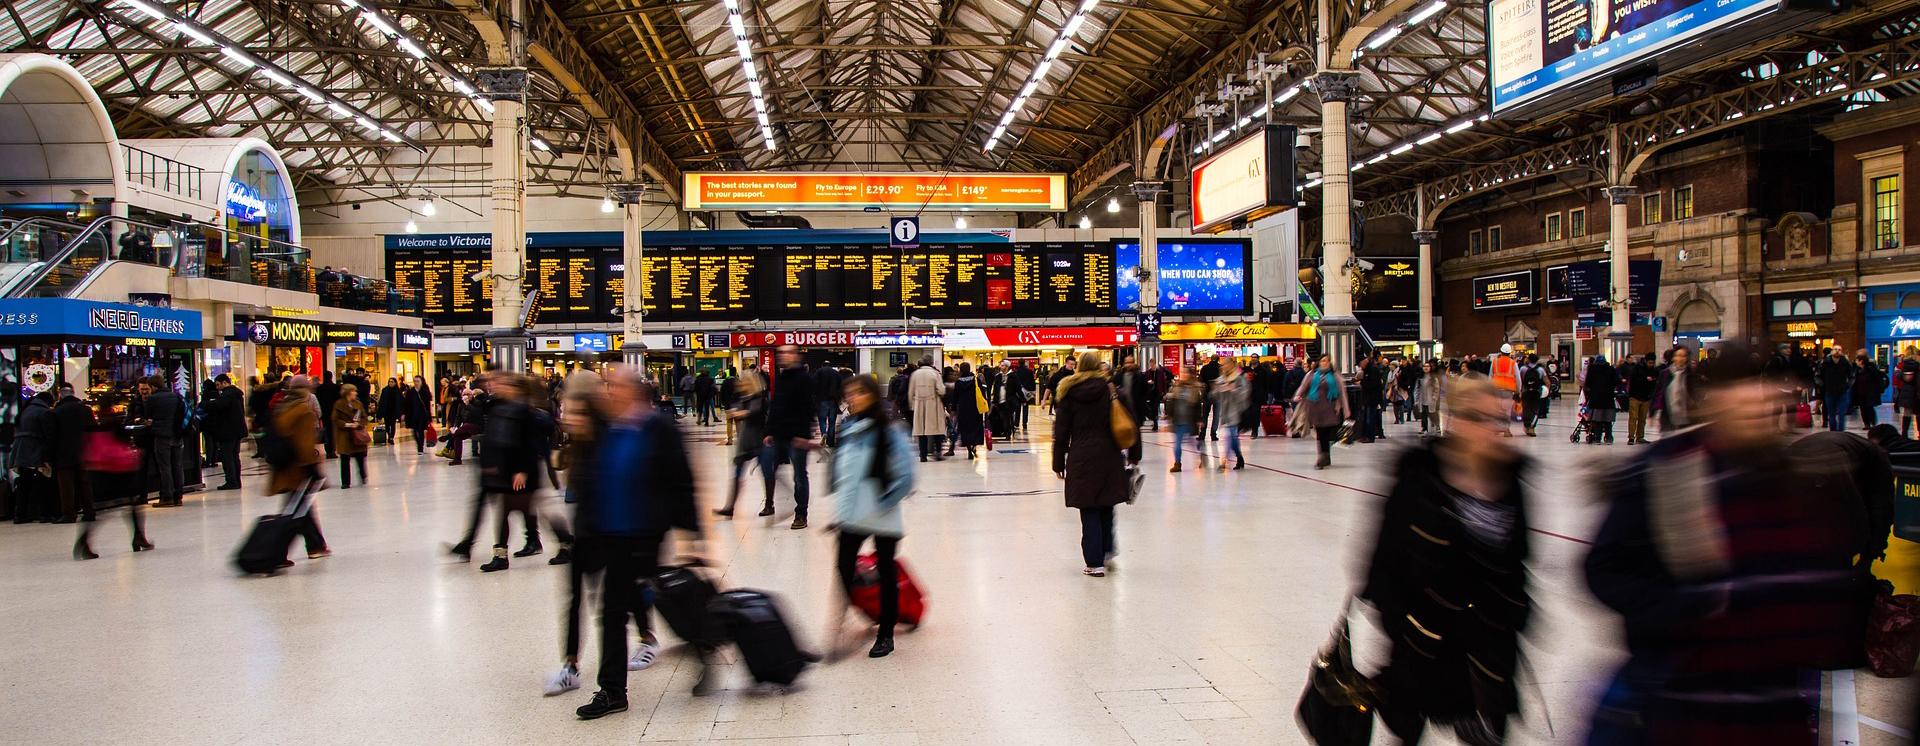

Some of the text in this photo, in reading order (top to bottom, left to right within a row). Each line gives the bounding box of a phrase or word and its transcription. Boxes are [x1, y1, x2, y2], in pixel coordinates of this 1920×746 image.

[1614, 5, 1633, 23] you
[1666, 12, 1694, 29] Supportive
[815, 183, 825, 192] Fly
[834, 184, 857, 192] Europe
[916, 184, 926, 192] Fly
[713, 192, 732, 200] your
[732, 191, 765, 199] passport.
[398, 235, 491, 247] Welcome to Victoria
[1161, 269, 1181, 279] WHEN
[1182, 269, 1196, 279] YOU
[1196, 269, 1211, 279] CAN
[1499, 280, 1517, 290] WESTFIELD
[140, 317, 185, 335] EXPRESS
[272, 321, 320, 342] MONSOON
[1215, 325, 1269, 338] Upper Crust
[125, 338, 156, 346] ESPRESSO BAR
[673, 336, 685, 346] 12
[785, 332, 847, 345] BURGER
[1017, 330, 1041, 344] GX
[469, 340, 481, 350] 10
